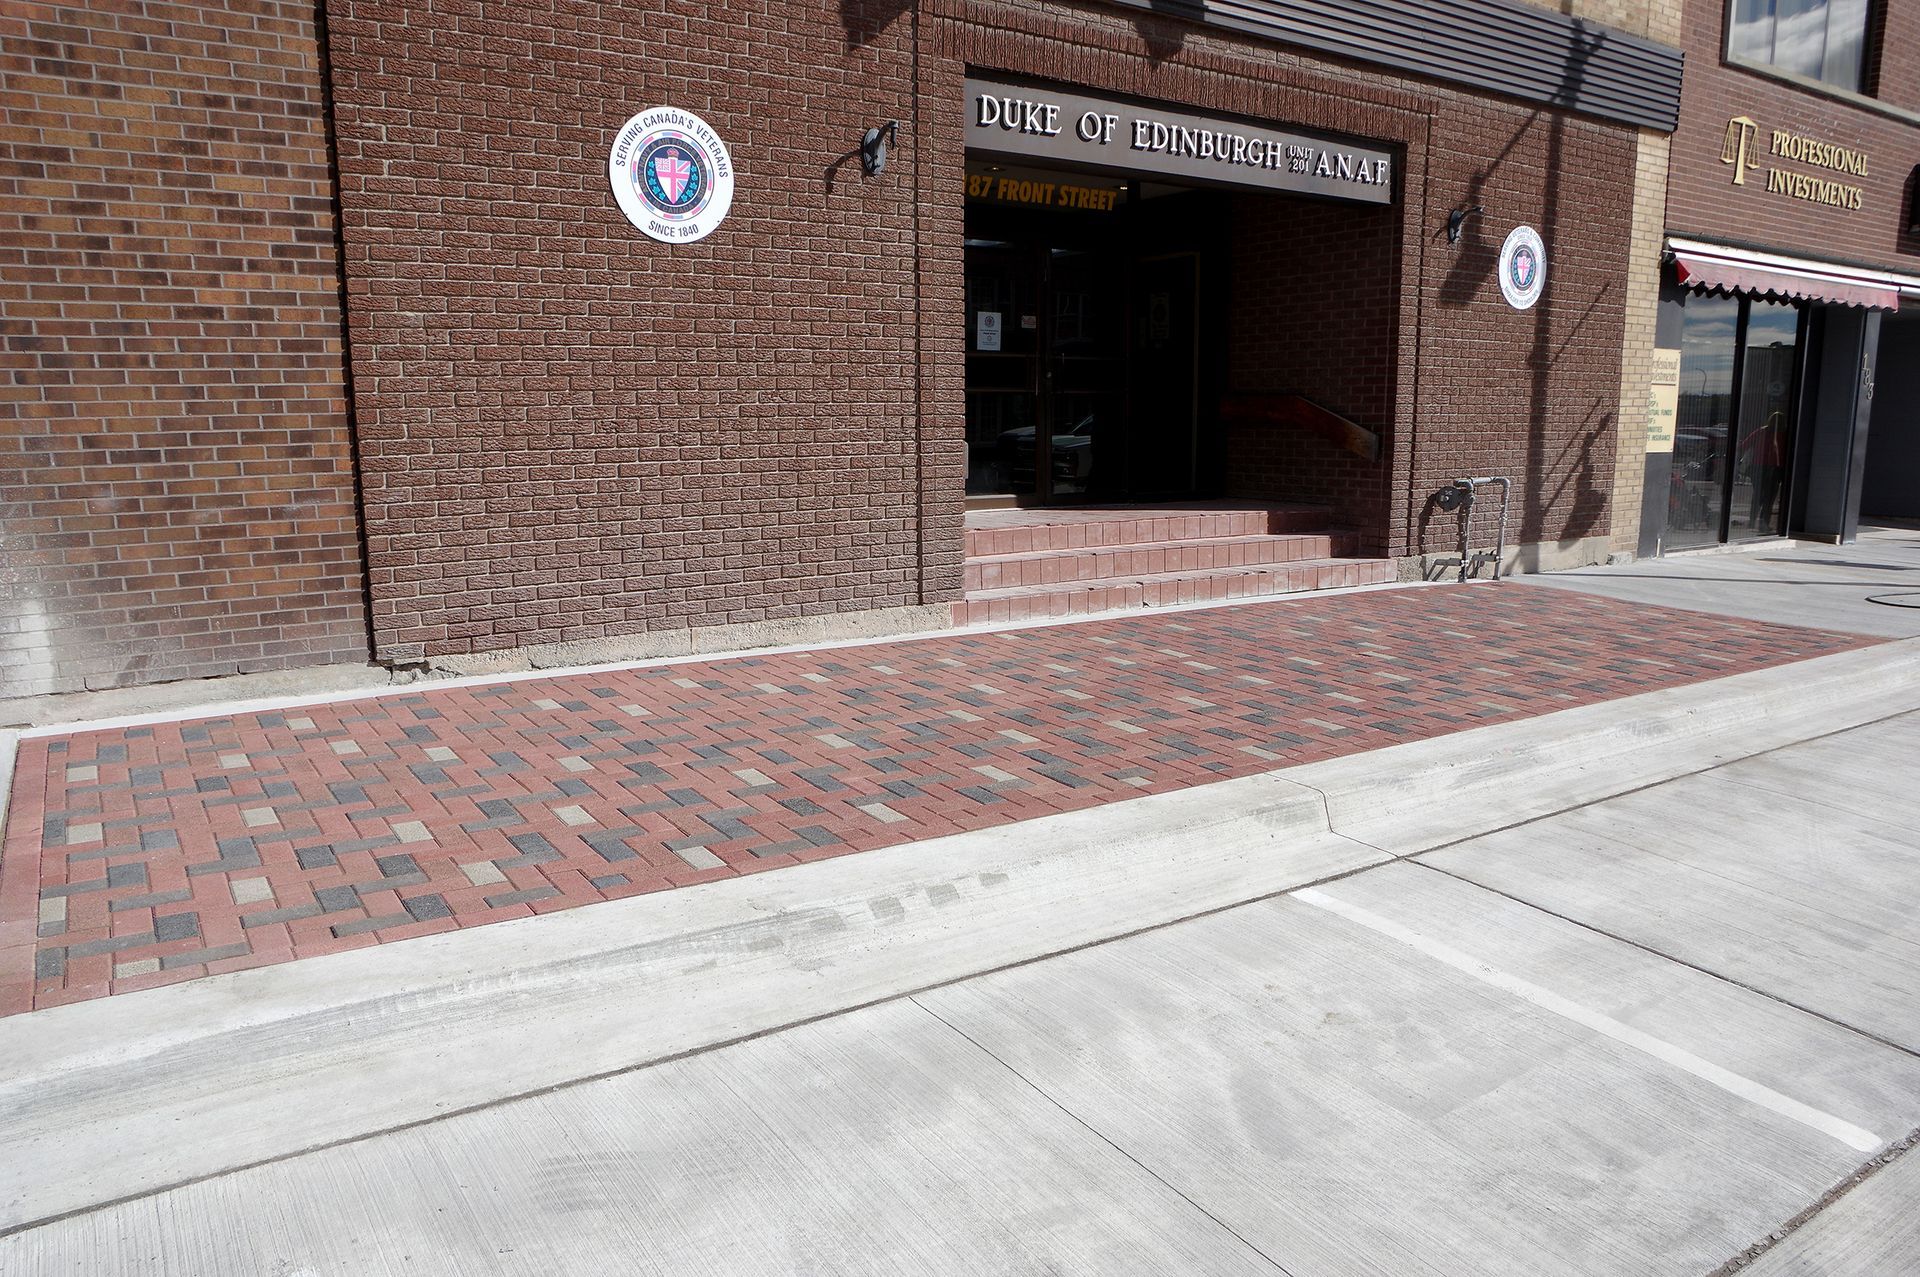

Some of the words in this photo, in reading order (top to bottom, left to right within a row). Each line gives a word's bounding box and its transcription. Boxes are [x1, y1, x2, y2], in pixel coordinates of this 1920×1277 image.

[615, 123, 643, 167] SERVING
[643, 113, 694, 130] CANADA'S
[696, 125, 729, 178] VETERANS
[980, 94, 1062, 134] DUKE
[1081, 111, 1119, 142] OF
[1135, 119, 1282, 168] EDINBURGH
[1289, 145, 1314, 160] UNIT
[1292, 158, 1309, 172] 201
[1316, 150, 1388, 183] A.N.A.F.
[1771, 130, 1868, 177] PROFESSIONAL
[966, 174, 993, 198] 87
[997, 178, 1056, 205] FRONT
[1058, 184, 1118, 211] STREET
[1767, 168, 1863, 210] INVESTMENTS
[648, 220, 676, 237] SINCE
[678, 223, 699, 237] 1840
